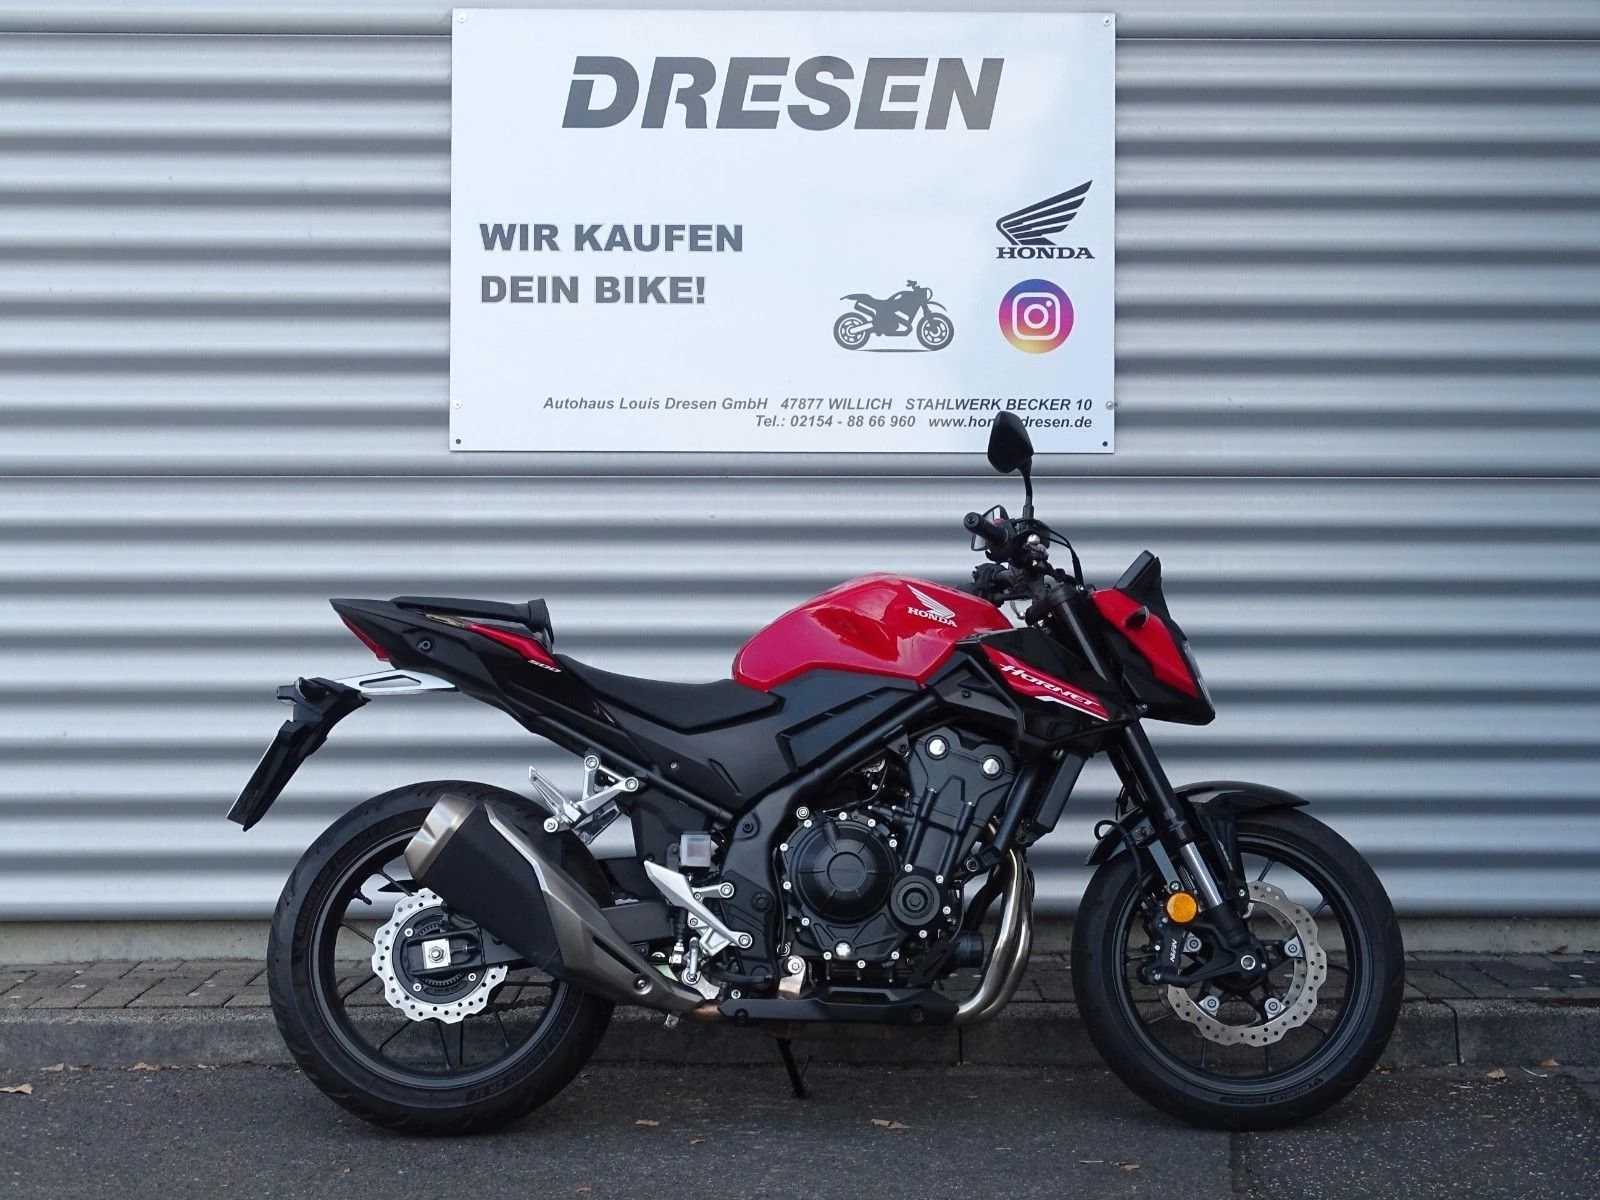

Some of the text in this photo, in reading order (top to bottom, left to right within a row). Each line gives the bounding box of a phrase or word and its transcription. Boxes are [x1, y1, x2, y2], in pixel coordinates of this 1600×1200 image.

[562, 56, 1004, 131] DRESEN
[480, 224, 743, 253] WIR KAUFEN
[996, 246, 1096, 260] HONDA
[481, 276, 705, 305] DEIN BIKE!
[543, 397, 1093, 412] Autohaus Louis Dresen GmbH 47877 WILLICH STAHLWERK BECKER 10
[755, 415, 786, 428] Tel.:
[790, 415, 834, 428] 02154
[846, 415, 865, 428] 88
[868, 415, 886, 428] 66
[889, 415, 916, 428] 960
[929, 415, 1093, 429] www.hondresen.de
[907, 606, 958, 628] HONDA
[527, 659, 562, 673] 500
[999, 663, 1100, 706] HORNET
